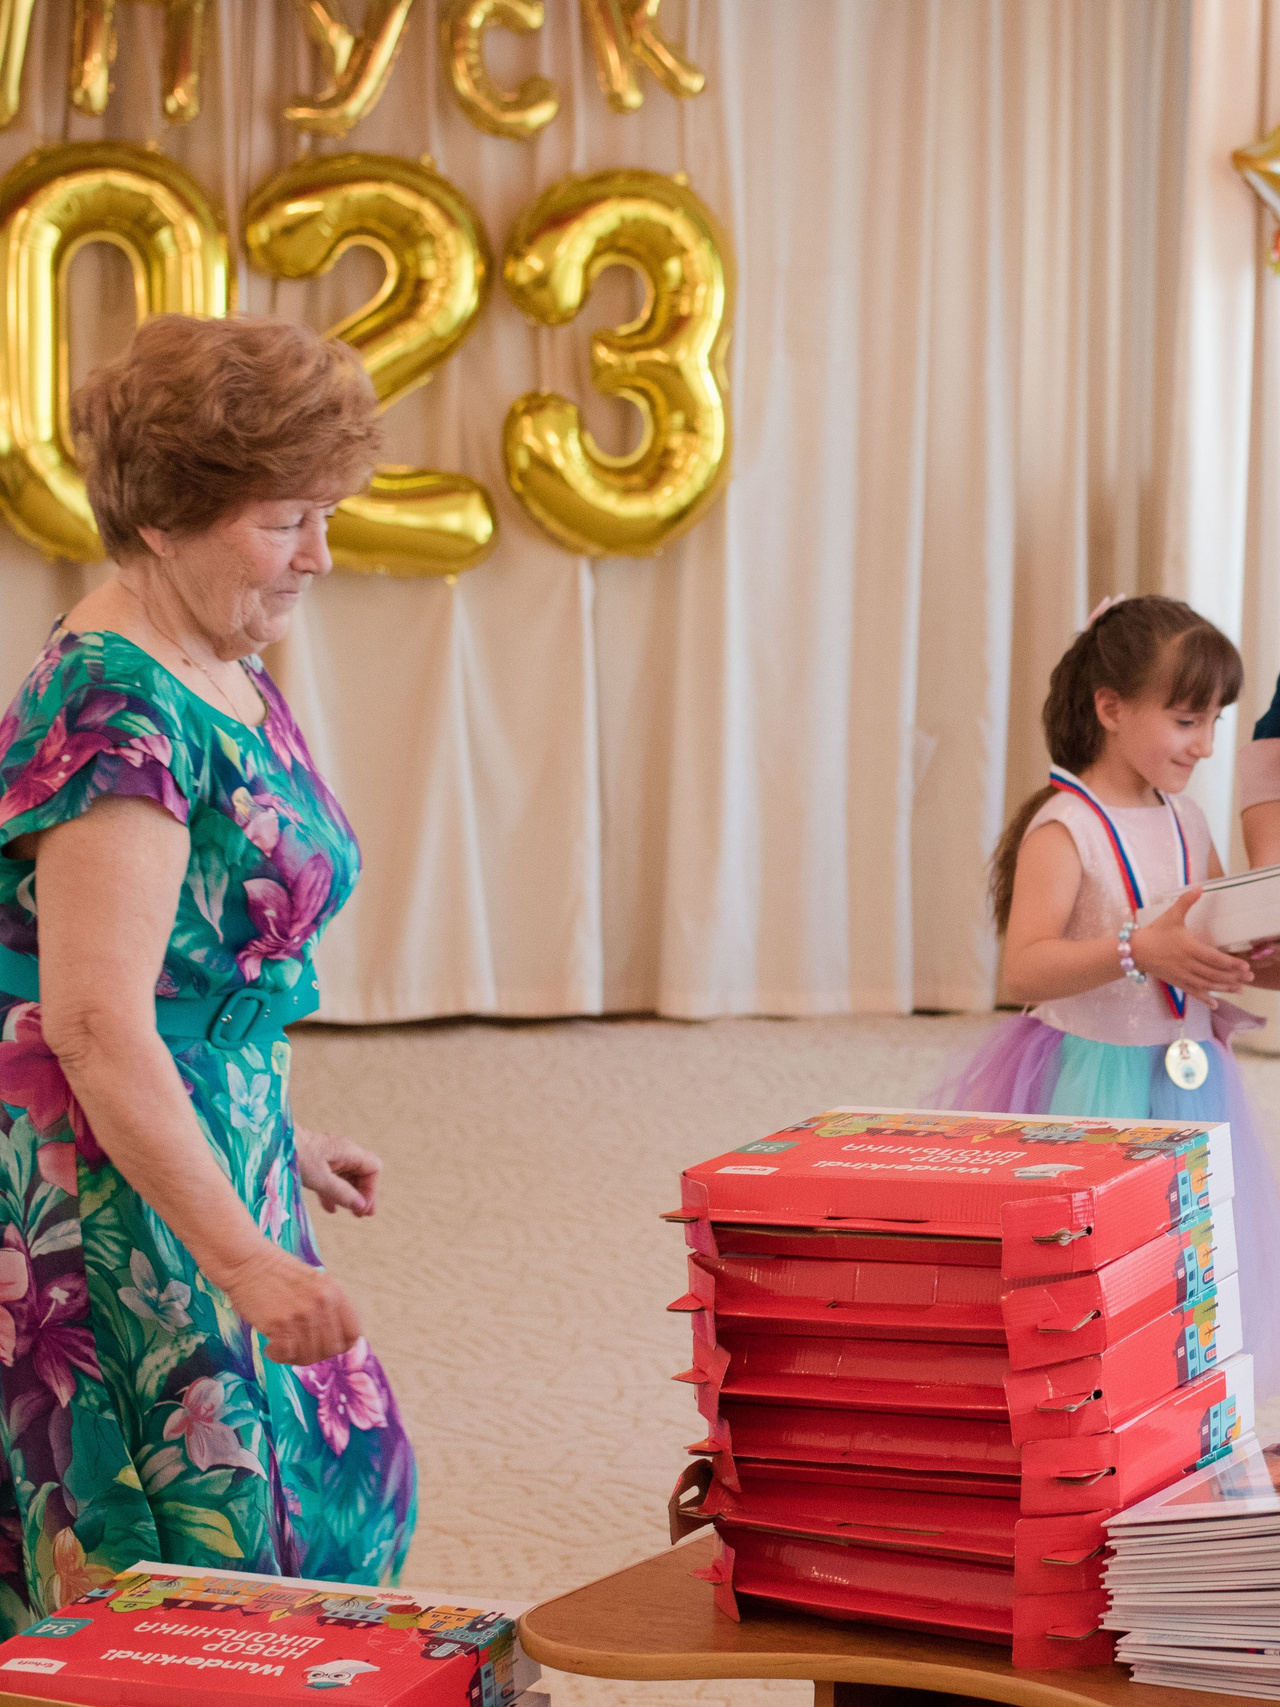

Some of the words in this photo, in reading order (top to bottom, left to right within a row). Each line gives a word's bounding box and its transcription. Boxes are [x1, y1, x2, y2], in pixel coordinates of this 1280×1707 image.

[747, 1144, 785, 1153] 34
[841, 1143, 1027, 1160] ШКОЛЬНИКА
[811, 1159, 991, 1174] Wunderkind!
[909, 1155, 1013, 1166] НАБОР
[36, 1623, 77, 1635] 34
[133, 1621, 325, 1649] ШКОЛЬНИКА
[203, 1641, 310, 1660] НАБОР
[17, 1660, 54, 1668] Erhaft
[99, 1649, 285, 1677] Wunderkind!
